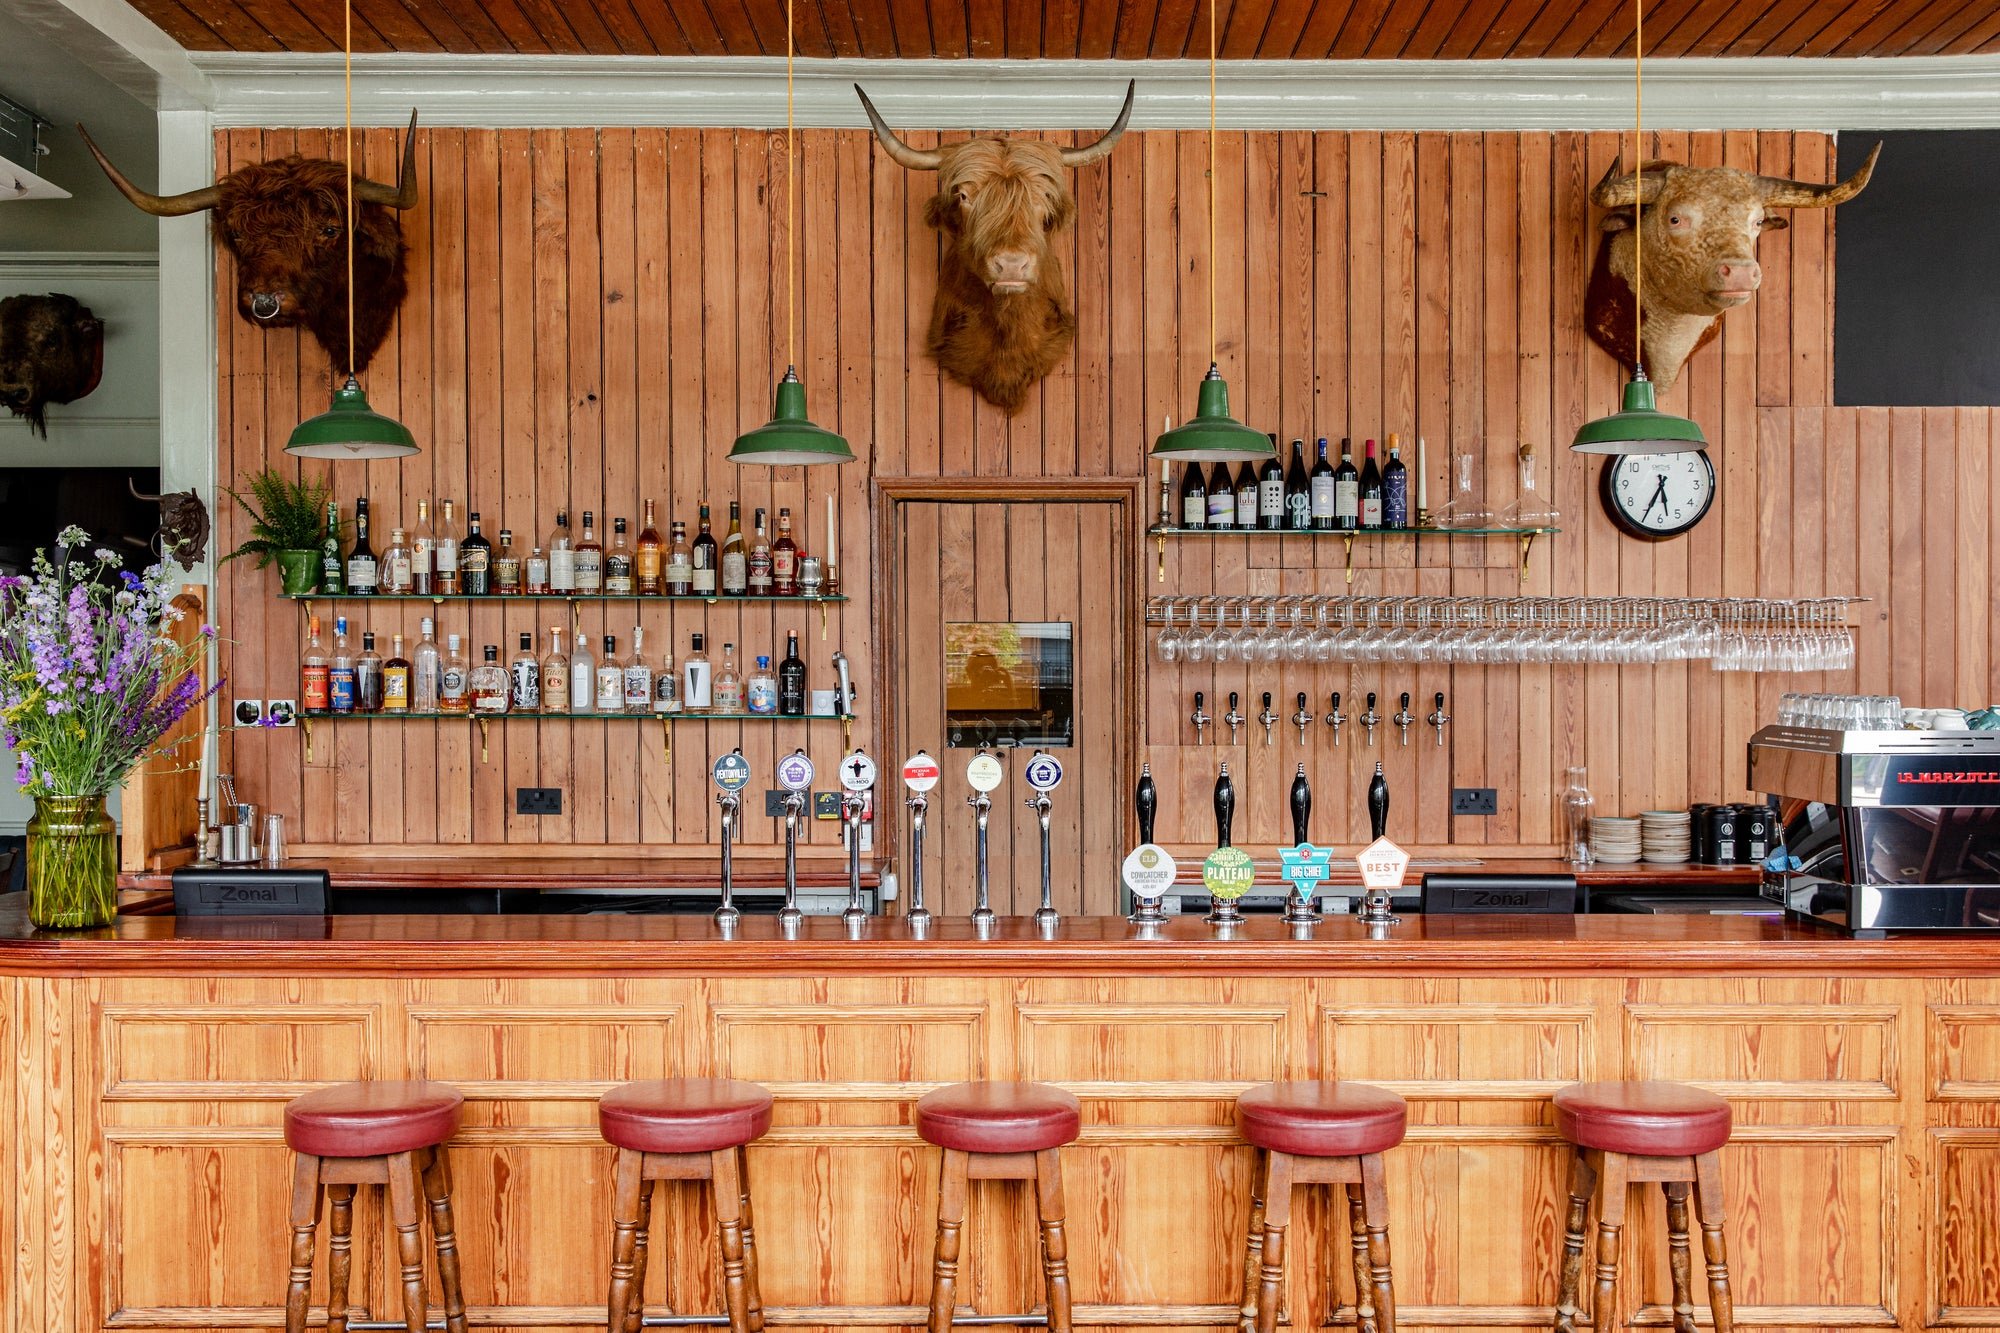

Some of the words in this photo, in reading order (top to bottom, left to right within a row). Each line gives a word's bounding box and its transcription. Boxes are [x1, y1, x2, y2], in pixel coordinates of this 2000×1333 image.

[1629, 462, 1640, 473] 10
[1687, 462, 1694, 473] 2
[1621, 479, 1629, 490] 9
[1693, 480, 1700, 490] 3
[1627, 496, 1634, 507] 8
[1687, 498, 1694, 508] 4
[1657, 513, 1664, 524] 6
[1674, 509, 1682, 520] 5
[1897, 772, 1914, 784] LA
[1918, 772, 2000, 784] MARZOCC
[1291, 866, 1303, 878] BIG
[1303, 866, 1322, 878] CHIEF
[1366, 862, 1401, 872] BEST
[1130, 871, 1169, 879] COWCATCHER
[1207, 867, 1251, 880] PLATEAU
[219, 885, 277, 901] Zonal
[1473, 891, 1529, 906] Zonal
